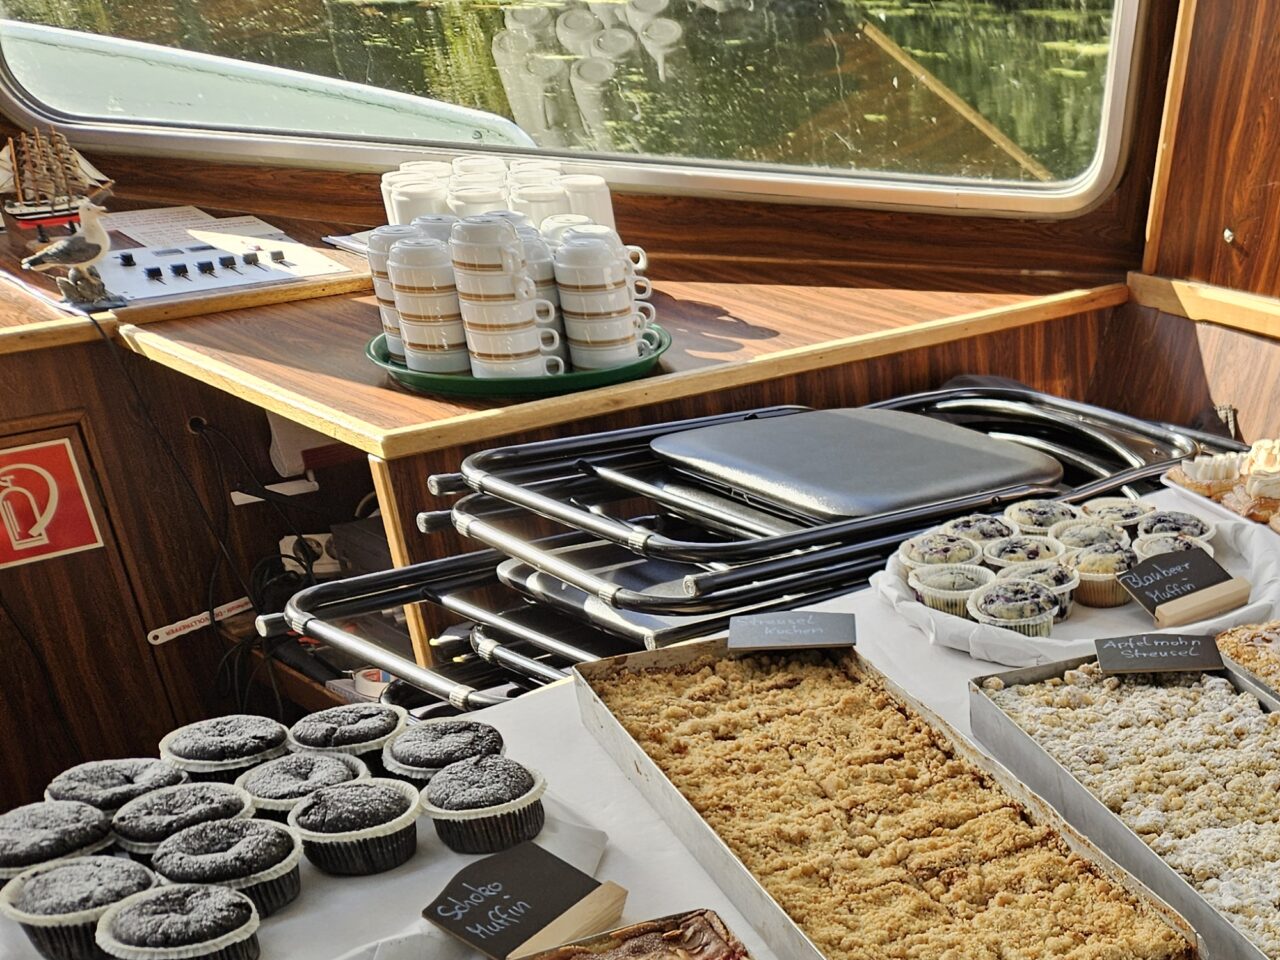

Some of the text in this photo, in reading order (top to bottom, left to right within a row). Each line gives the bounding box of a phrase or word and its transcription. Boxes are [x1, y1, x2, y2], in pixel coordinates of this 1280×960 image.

[1120, 562, 1190, 588] Blaubeer
[1145, 578, 1195, 602] Muffin
[1103, 636, 1201, 649] Apfelmohn
[1120, 647, 1201, 658] Streusel
[436, 881, 504, 920] Schoko
[466, 895, 533, 939] Muffin
